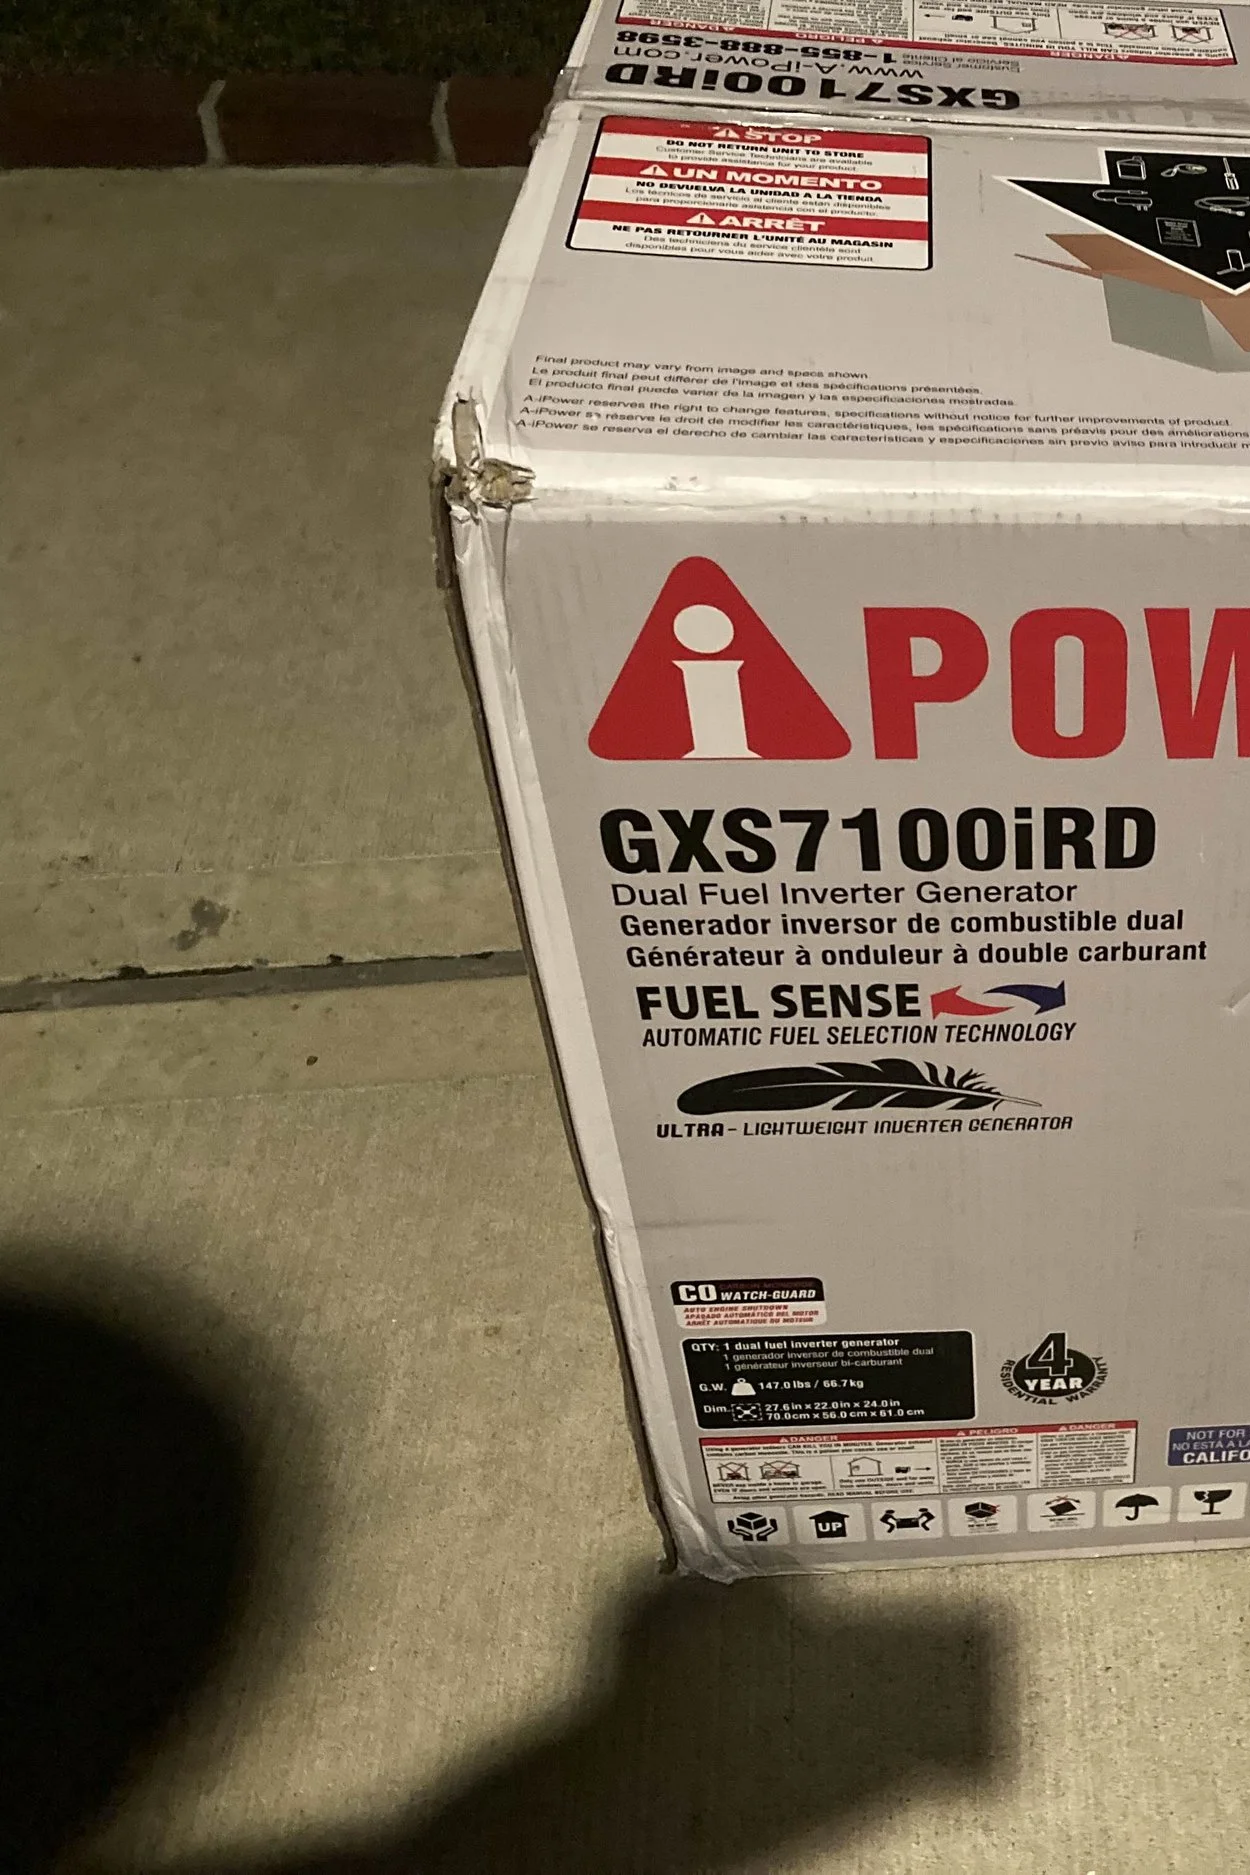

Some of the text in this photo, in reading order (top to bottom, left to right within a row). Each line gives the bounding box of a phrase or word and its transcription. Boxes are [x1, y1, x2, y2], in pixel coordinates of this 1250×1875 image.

[605, 63, 1020, 110] GXS7100iRD
[744, 127, 822, 143] STOP
[717, 143, 768, 152] RETURN
[824, 150, 863, 158] STORE
[672, 167, 882, 190] UN MOMENTO
[659, 182, 724, 192] DEVUELVA
[750, 188, 799, 197] UNIDAD
[837, 194, 882, 202] TIENDA
[719, 214, 826, 232] ARRÊT
[666, 228, 748, 239] RETOURNER
[753, 234, 804, 243] L'UNITÉ
[830, 238, 892, 247] MAGASIN
[535, 354, 567, 363] Final
[570, 358, 619, 367] product
[622, 362, 650, 370] may
[654, 363, 681, 371] vary
[685, 364, 713, 372] from
[717, 366, 756, 375] image
[600, 806, 1156, 874] GXS7100iRD
[611, 880, 1077, 905] Dual Fuel Inverter Generator
[620, 909, 1183, 936] Generador inversor de combustible dual
[626, 940, 1206, 967] Générateur à onduleur à double carburant
[635, 983, 922, 1021] FUEL SENSE
[642, 1022, 1076, 1047] AUTOMATIC FUEL SELECTION TECHNOLOGY
[656, 1122, 724, 1138] ULTRA
[743, 1120, 868, 1135] LIGHTWEIGHT
[874, 1118, 962, 1133] INVERTER
[968, 1116, 1072, 1131] GENERATOR
[678, 1284, 717, 1302] CO
[720, 1289, 817, 1301] WATCH-GUARD
[691, 1342, 718, 1351] QTY:
[734, 1341, 760, 1350] dual
[764, 1340, 786, 1349] fuel
[790, 1339, 837, 1348] inverter
[841, 1338, 898, 1350] generator
[732, 1352, 784, 1362] generador
[787, 1351, 828, 1359] inversor
[831, 1350, 844, 1358] de
[847, 1348, 909, 1358] combustible
[912, 1347, 933, 1355] dual
[1026, 1332, 1074, 1377] 4
[734, 1360, 788, 1371] générateur
[840, 1358, 902, 1366] bi-carburant
[1000, 1359, 1057, 1405] RESIDENTIAL
[1024, 1377, 1083, 1392] YEAR
[1065, 1355, 1109, 1404] WARRANTY
[1187, 1430, 1213, 1440] NOT
[1218, 1429, 1245, 1439] FOR
[1172, 1442, 1190, 1451] NO
[1193, 1439, 1223, 1450] ESTÁ
[818, 1521, 843, 1534] UP
